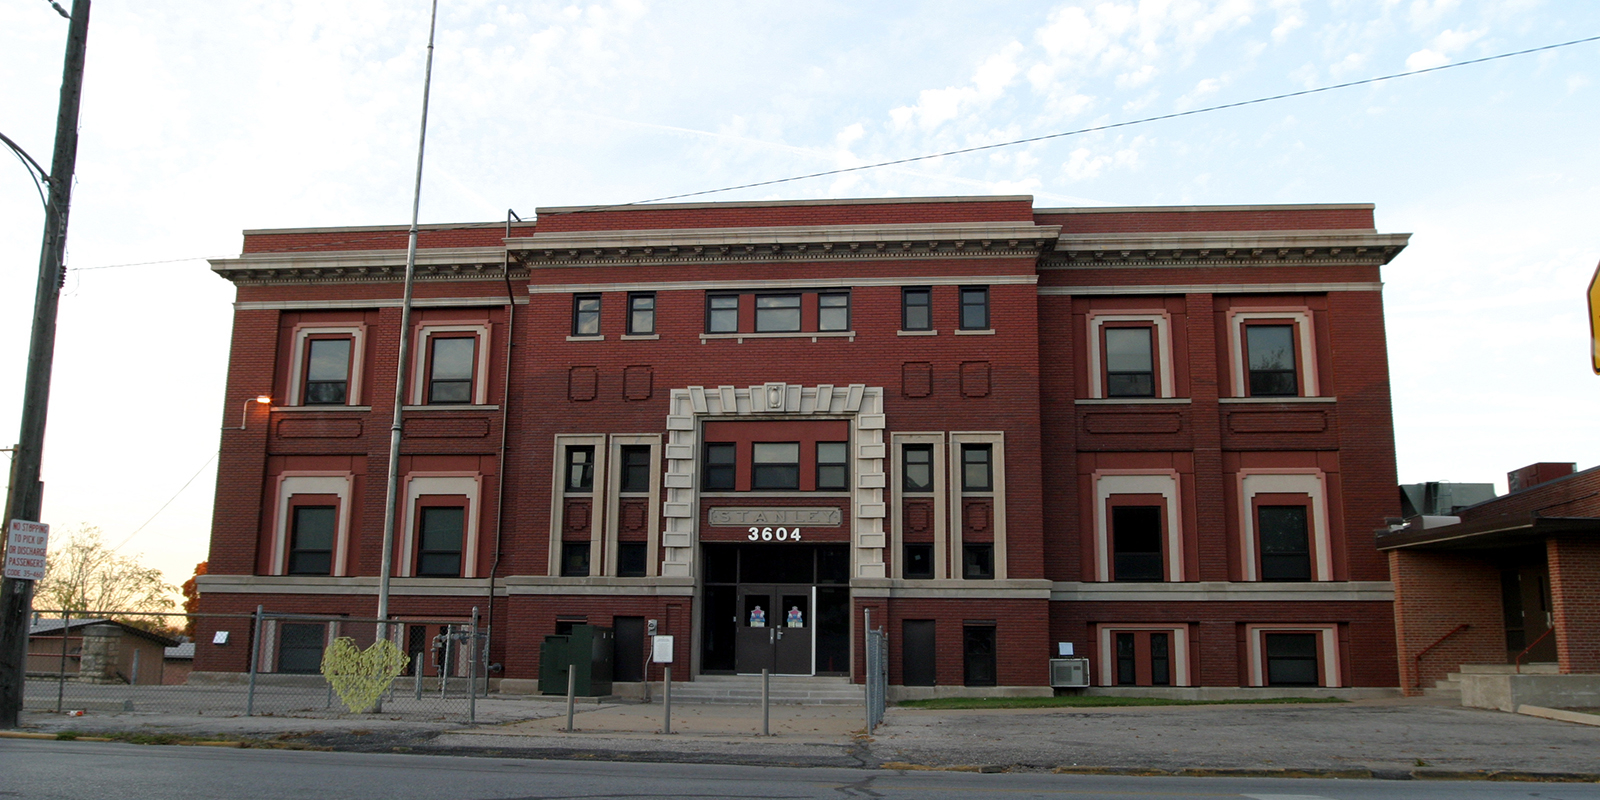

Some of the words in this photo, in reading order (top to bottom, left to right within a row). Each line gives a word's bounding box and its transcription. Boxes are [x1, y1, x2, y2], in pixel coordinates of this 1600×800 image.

[720, 511, 836, 523] STANLEY
[13, 522, 21, 530] NO
[22, 523, 47, 533] STOPPING
[15, 534, 21, 543] TO
[23, 535, 35, 544] PICK
[37, 536, 44, 545] UP
[748, 527, 802, 541] 3604
[9, 545, 16, 554] OR
[18, 546, 46, 557] DISCHARGE
[9, 557, 44, 568] PASSENGERS
